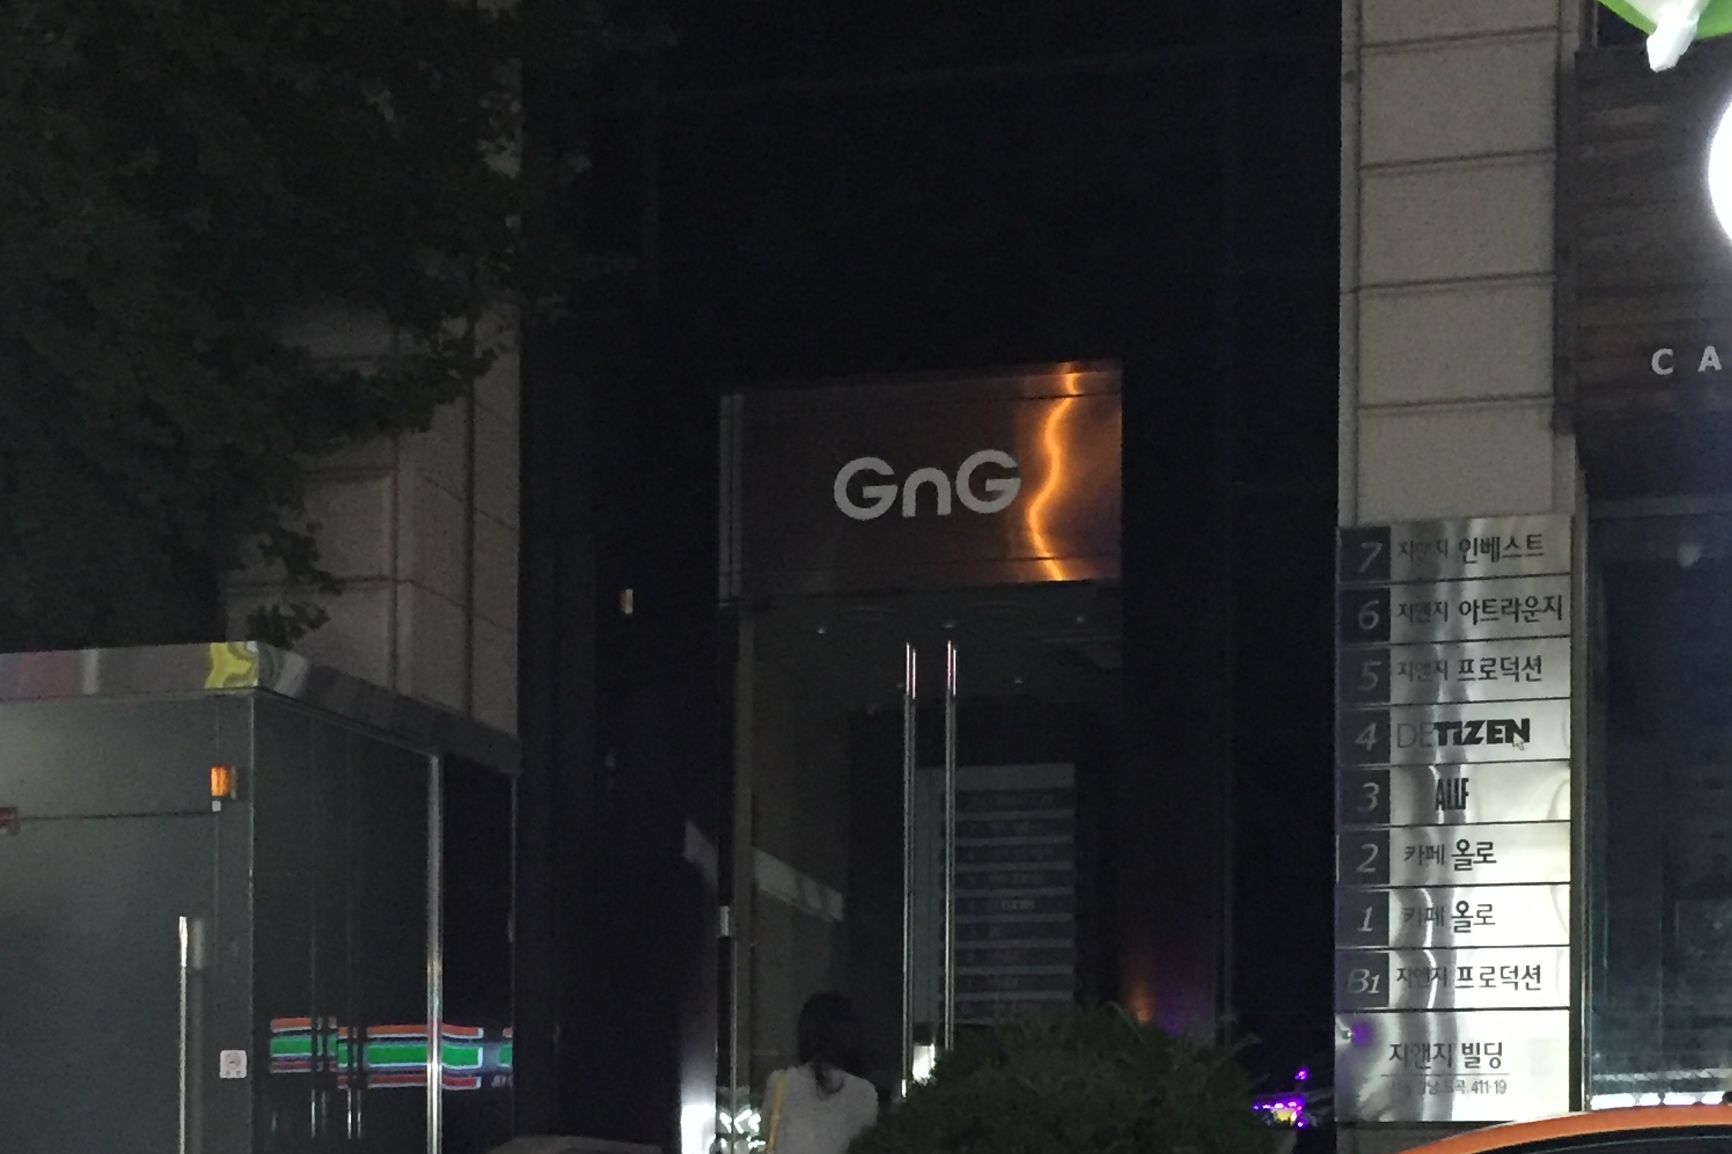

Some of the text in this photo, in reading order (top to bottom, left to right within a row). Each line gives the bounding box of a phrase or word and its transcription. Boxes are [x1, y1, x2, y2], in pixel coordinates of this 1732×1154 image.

[834, 449, 1021, 521] GnG
[1359, 542, 1383, 573] 7
[1458, 533, 1544, 564] 인베스트
[1358, 600, 1381, 630] 6
[1458, 595, 1562, 625] 아트라운지
[1359, 661, 1382, 692] 5
[1457, 655, 1542, 682] 프로덕션
[1355, 722, 1377, 750] 4
[1360, 782, 1380, 812] 3
[1356, 843, 1379, 873] 2
[1404, 838, 1497, 871] 카페 올로
[1357, 905, 1374, 932] 1
[1404, 900, 1496, 933] 카페 올로
[1350, 967, 1381, 995] B1
[1455, 964, 1542, 991] 프로덕션
[1389, 1041, 1504, 1071] 지앤지 빌딩
